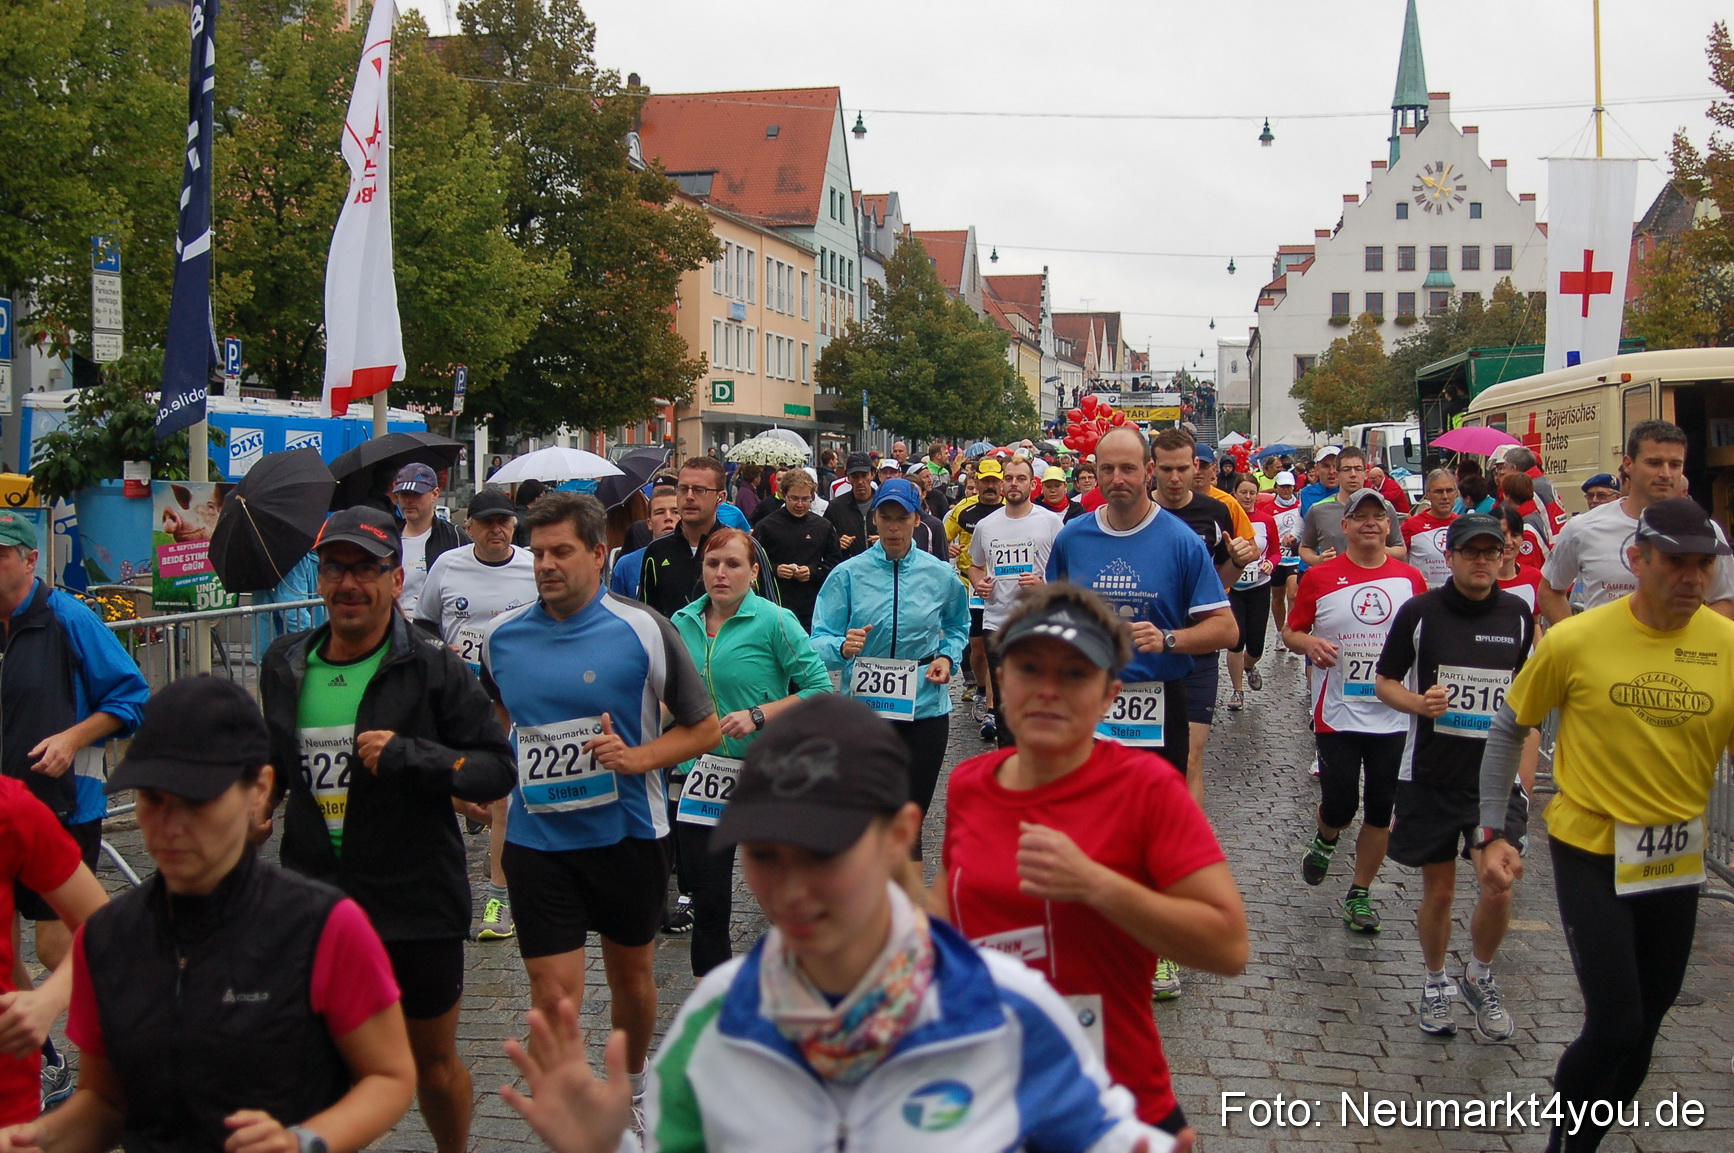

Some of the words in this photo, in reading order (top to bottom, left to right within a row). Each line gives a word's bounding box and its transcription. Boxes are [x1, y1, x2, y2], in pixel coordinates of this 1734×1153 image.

[228, 343, 238, 371] P
[715, 383, 731, 400] D
[1546, 402, 1597, 431] Bayerisches
[1545, 432, 1569, 452] Rotes
[1544, 456, 1568, 475] Kreuz
[161, 554, 184, 565] BEIDE
[185, 551, 209, 562] STIM
[995, 547, 1029, 565] 2111
[182, 561, 205, 572] GRÜN
[196, 583, 217, 593] UND
[1128, 590, 1159, 599] Stadtlauf
[1481, 635, 1515, 644] PFLEIDERER
[856, 671, 908, 696] 2361
[1440, 671, 1465, 681] PARTL
[1467, 674, 1502, 683] Neumarkt
[1634, 674, 1689, 693] PIZZERIA
[866, 699, 895, 710] Sabine
[1446, 683, 1505, 712] 2516
[1623, 686, 1701, 711] FRANCESCO
[1104, 695, 1158, 721] 362
[544, 727, 590, 742] Neumarkt
[1110, 725, 1141, 737] Stefan
[304, 737, 353, 748] Neumarkt
[526, 740, 598, 780] 2227
[547, 784, 588, 801] Stefan
[688, 770, 737, 800] 262
[319, 801, 345, 816] eter
[700, 804, 724, 817] Ann
[1636, 821, 1689, 858] 446
[1643, 863, 1675, 878] Bruno
[988, 941, 1023, 954] EHN
